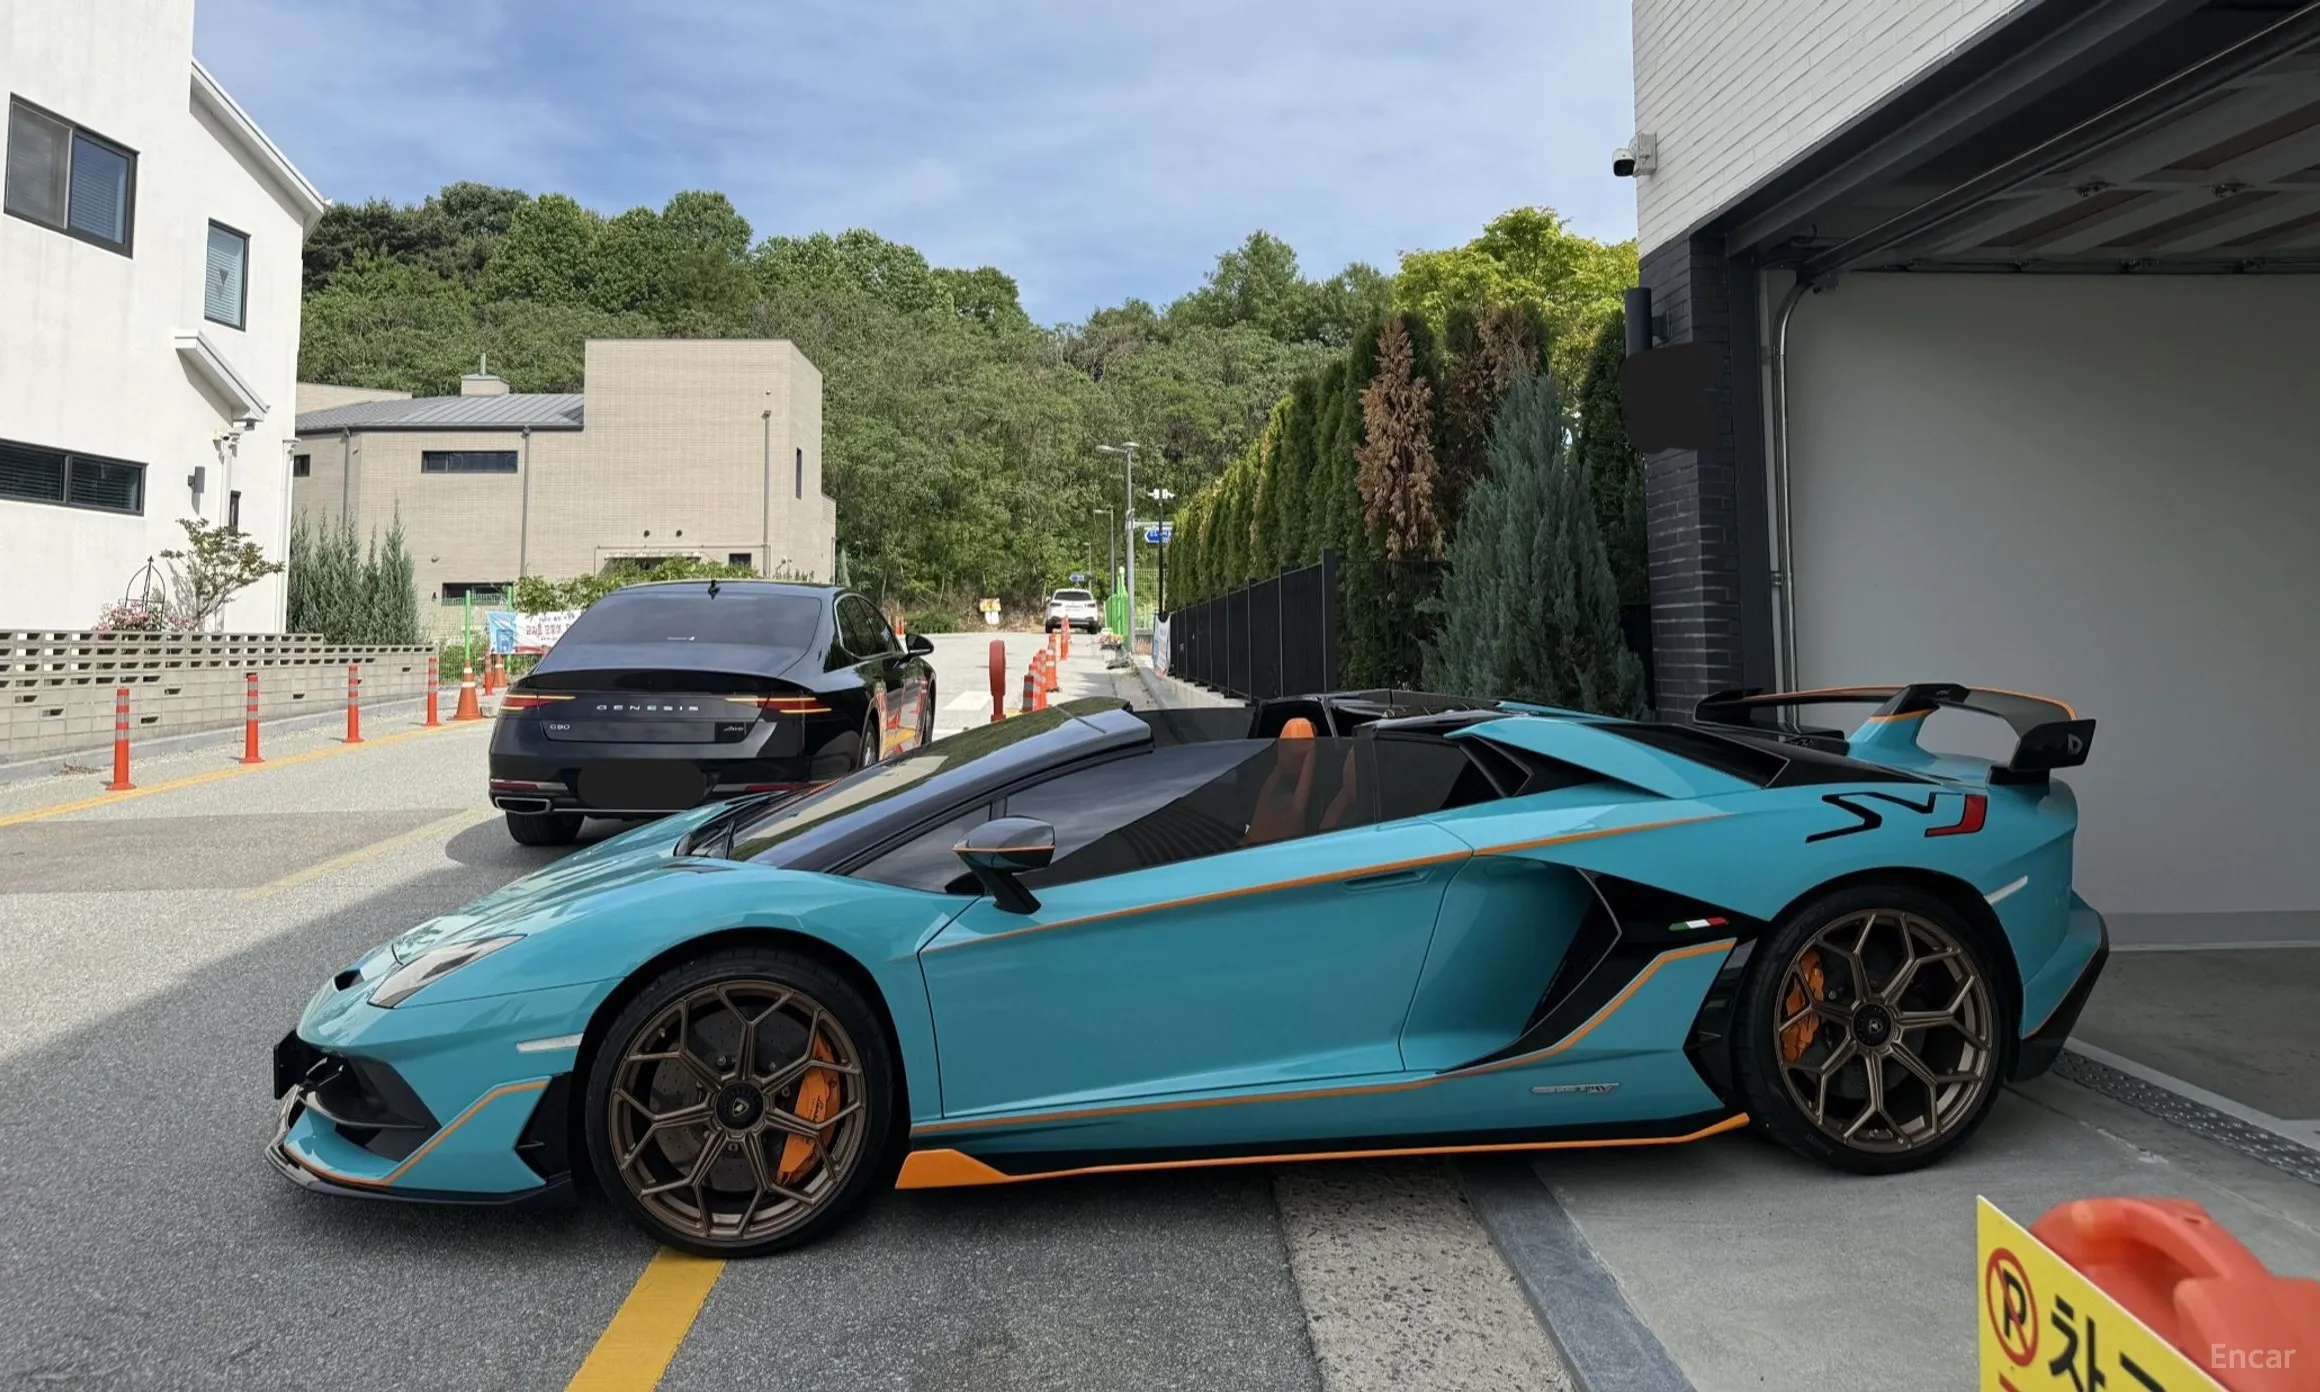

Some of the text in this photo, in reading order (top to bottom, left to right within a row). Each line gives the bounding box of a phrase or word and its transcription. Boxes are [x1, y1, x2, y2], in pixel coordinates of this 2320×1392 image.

[596, 704, 699, 712] GENESIS
[549, 723, 571, 731] G90
[1805, 791, 1988, 844] SVJ
[2048, 1293, 2167, 1392] 차
